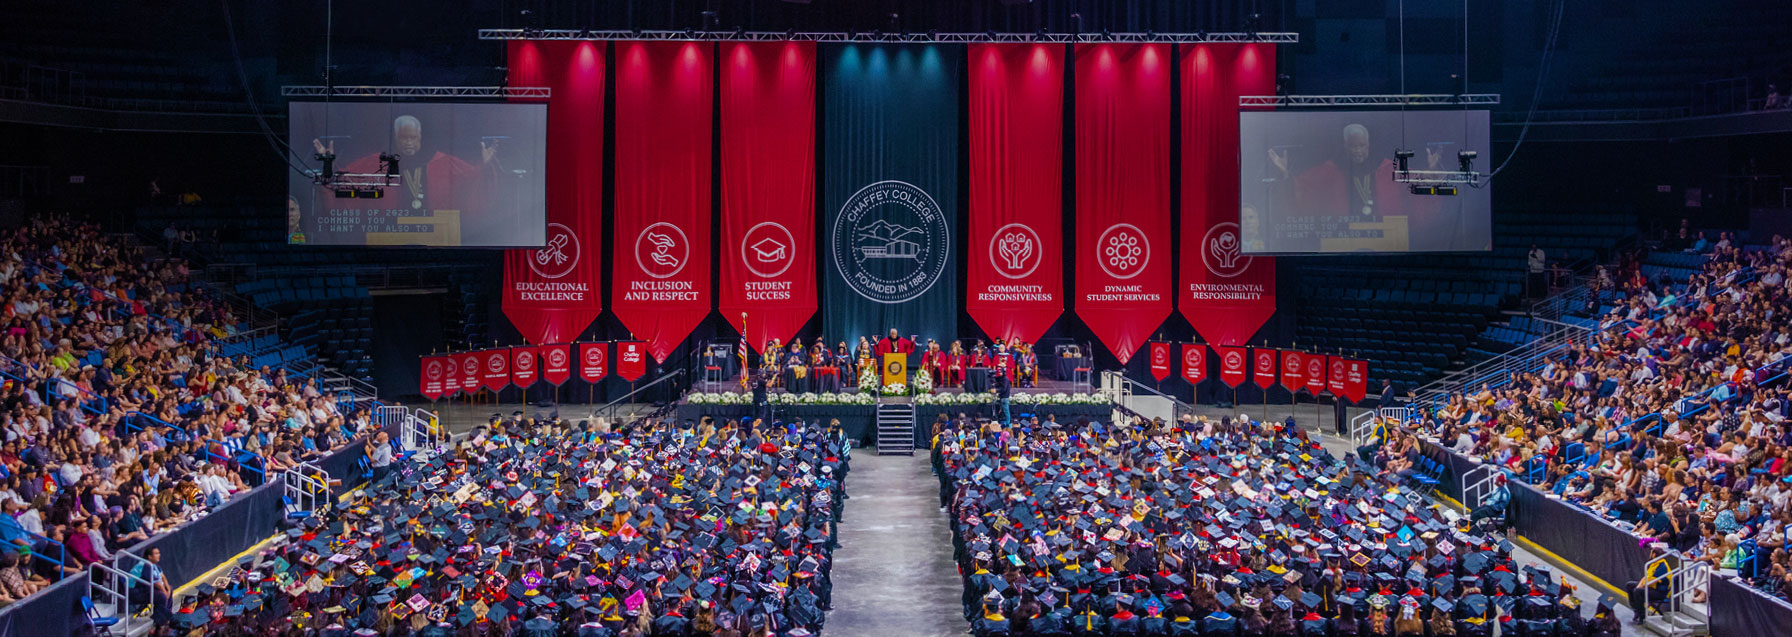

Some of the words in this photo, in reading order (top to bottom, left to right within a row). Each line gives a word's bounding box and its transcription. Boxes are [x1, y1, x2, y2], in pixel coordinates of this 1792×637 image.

[847, 189, 890, 222] CHAFFEY
[891, 189, 936, 224] COLLEGE
[516, 282, 589, 292] EDUCATIONAL
[631, 281, 693, 291] INCLUSION
[744, 281, 792, 291] STUDENT
[855, 271, 897, 294] FOUNDED
[898, 283, 908, 292] IN
[908, 271, 927, 288] 1883
[1190, 283, 1264, 292] ENVIRONMENTAL
[988, 285, 1043, 293] COMMUNITY
[1105, 285, 1142, 293] DYNAMIC
[521, 291, 584, 301] EXCELLENCE
[624, 291, 650, 301] AND
[652, 291, 699, 301] RESPECT
[746, 290, 791, 300] SUCCESS
[978, 293, 1052, 302] RESPONSIVENESS
[1087, 293, 1123, 301] STUDENT
[1123, 293, 1160, 302] SERVICES
[1193, 292, 1262, 300] RESPONSIBILITY
